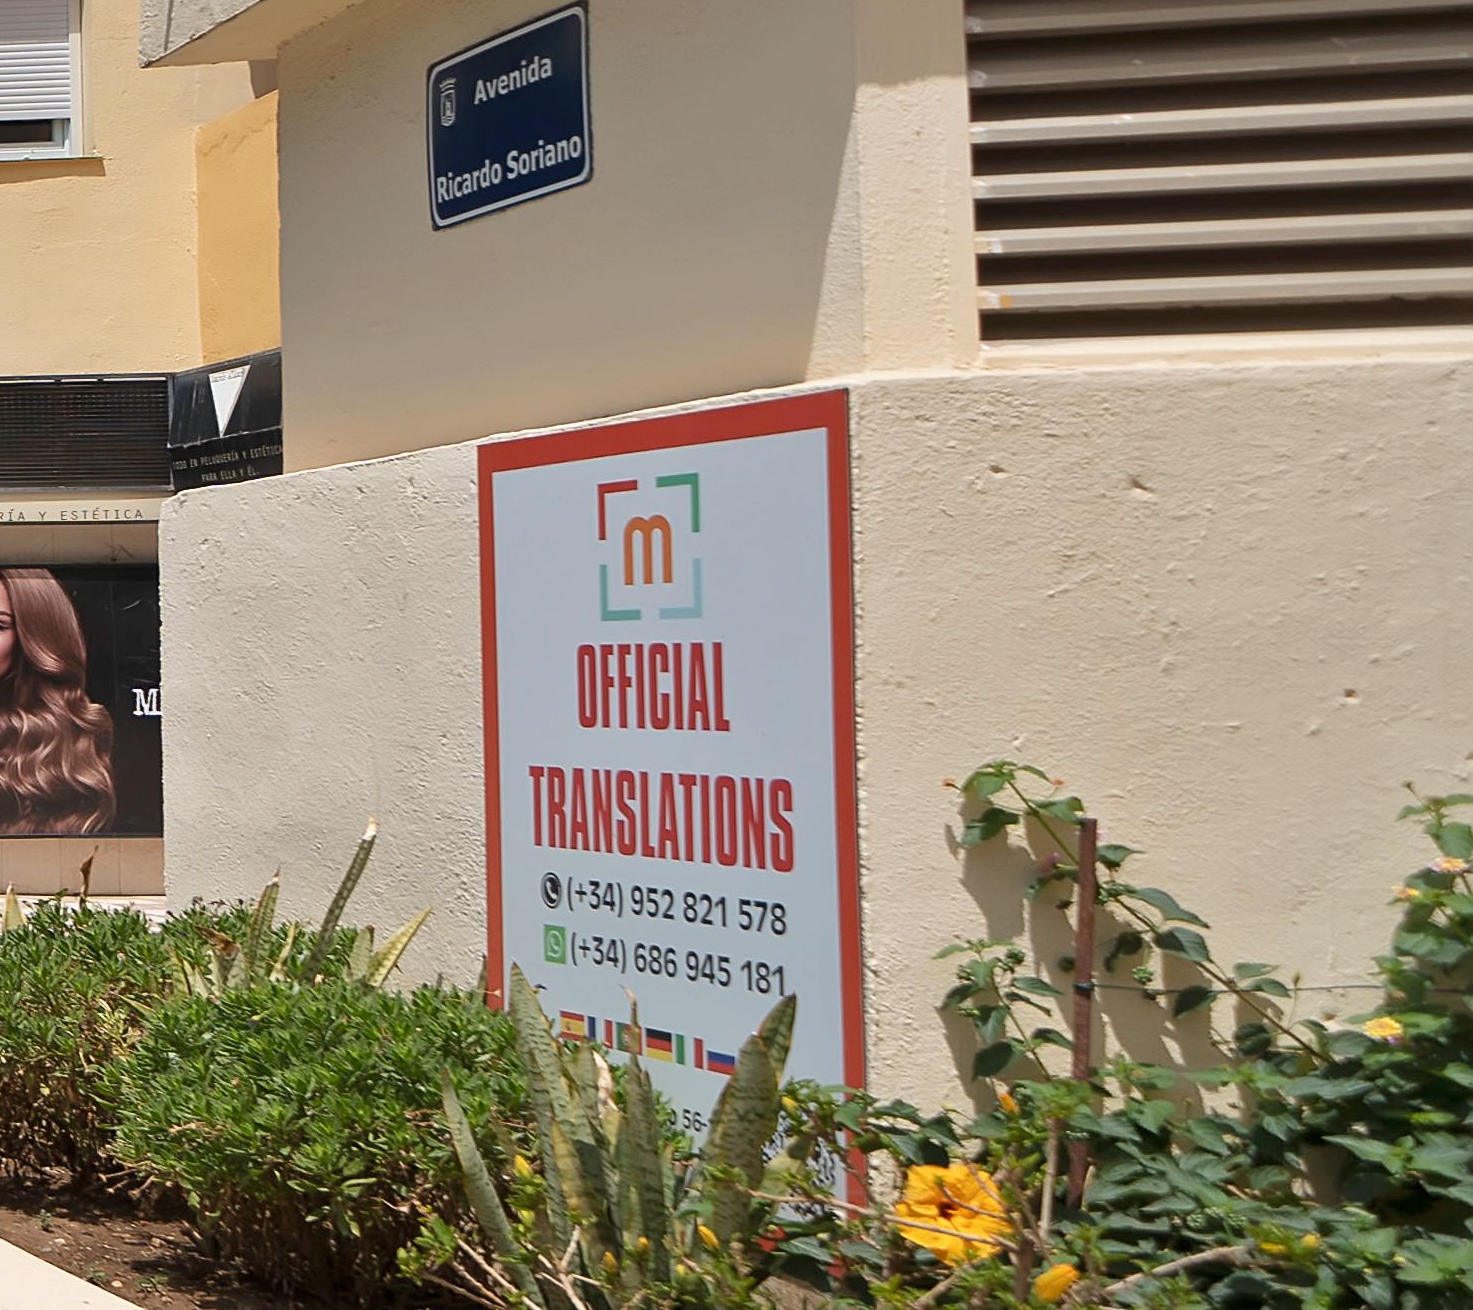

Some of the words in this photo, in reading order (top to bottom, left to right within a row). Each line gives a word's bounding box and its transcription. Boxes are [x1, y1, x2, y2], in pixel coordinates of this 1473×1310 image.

[474, 56, 552, 105] Avenida
[437, 160, 502, 203] Ricardo
[507, 136, 581, 179] Soriano
[38, 510, 47, 520] Y
[60, 507, 144, 520] ESTÉTICA
[576, 642, 730, 732] OFFICIAL
[527, 764, 795, 873] TRANSLATIONS
[567, 876, 623, 918] (+34)
[631, 884, 675, 920] 952
[683, 891, 727, 928] 821
[737, 898, 787, 936] 578
[570, 931, 626, 975] (+34)
[634, 942, 677, 978] 686
[685, 950, 731, 988] 945
[740, 960, 787, 997] 181
